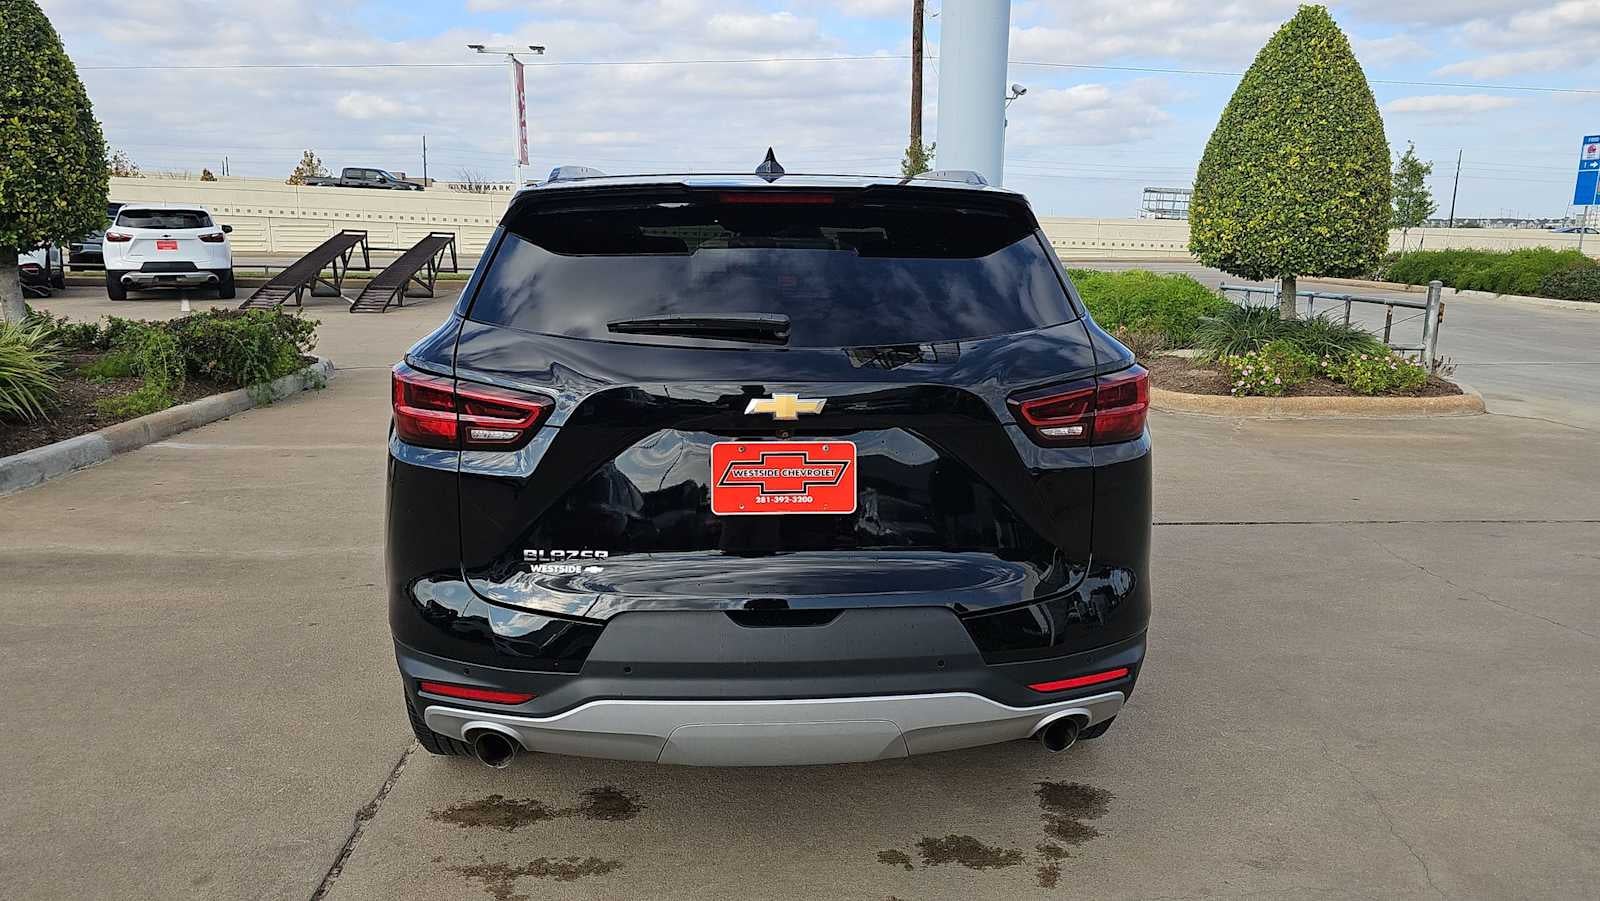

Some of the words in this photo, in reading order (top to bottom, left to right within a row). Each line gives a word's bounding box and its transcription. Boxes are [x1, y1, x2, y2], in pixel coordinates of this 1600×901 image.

[732, 468, 779, 478] WESTSIDE
[781, 468, 836, 477] CHEVROLET
[755, 496, 813, 504] 281-392-3200
[523, 549, 609, 561] BLAZER
[530, 564, 582, 573] WESTSIDE
